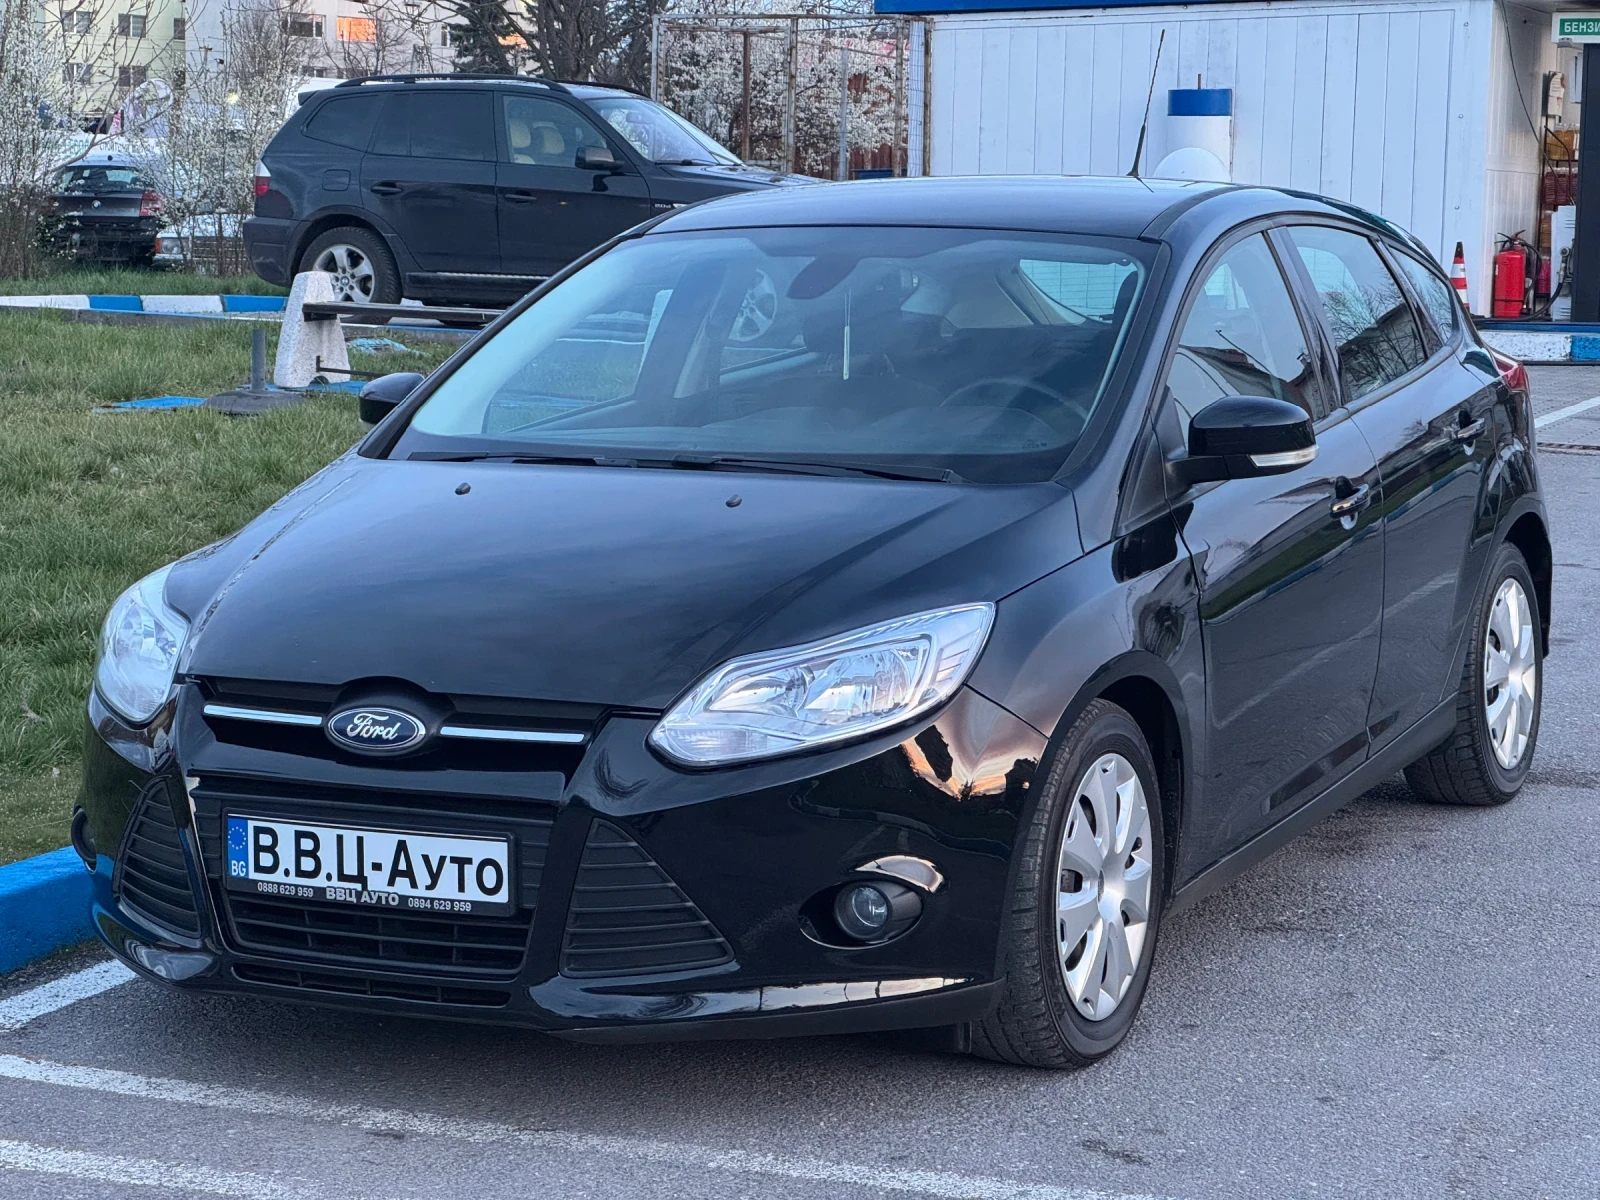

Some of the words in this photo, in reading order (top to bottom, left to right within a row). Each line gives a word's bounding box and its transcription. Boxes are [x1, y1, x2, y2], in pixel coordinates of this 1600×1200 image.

[346, 712, 402, 741] Ford
[231, 859, 247, 877] BG
[257, 881, 279, 894] 0888
[279, 884, 296, 896] 629
[297, 887, 314, 898] 959
[325, 886, 357, 904] ВВЦ
[360, 890, 400, 906] АУТО
[408, 897, 432, 909] 0894
[433, 899, 452, 911] 629
[453, 901, 472, 912] 959
